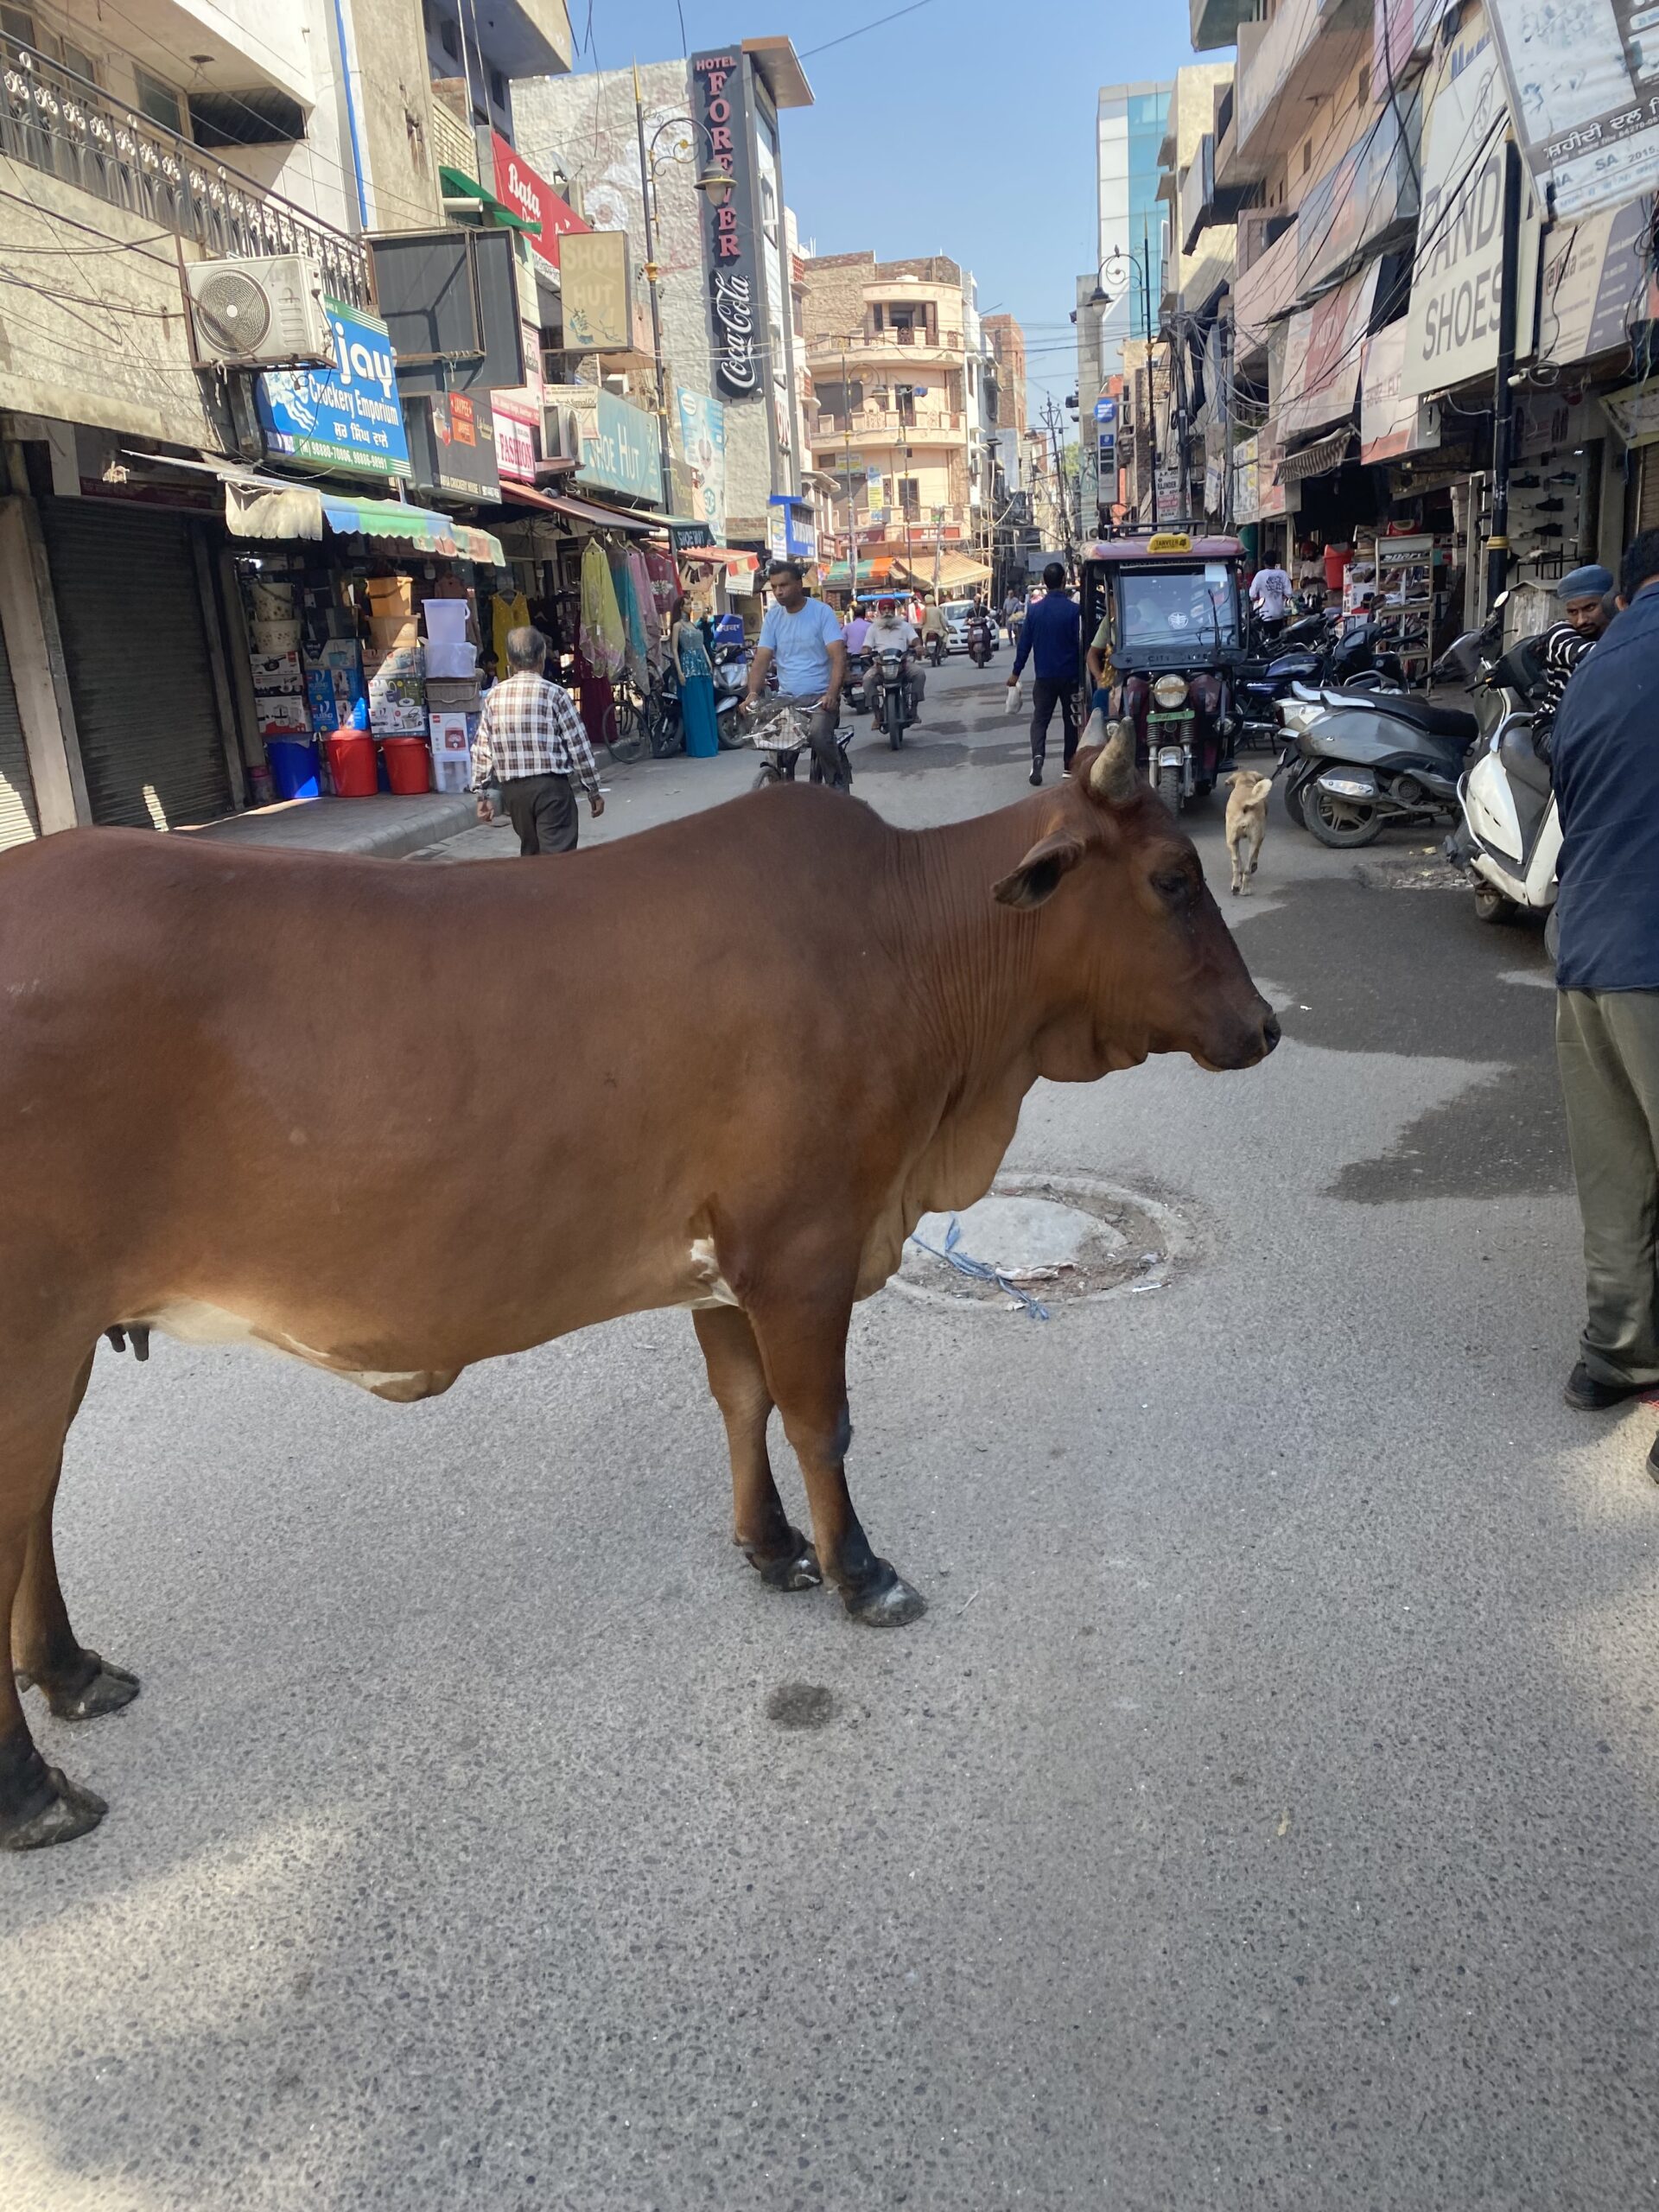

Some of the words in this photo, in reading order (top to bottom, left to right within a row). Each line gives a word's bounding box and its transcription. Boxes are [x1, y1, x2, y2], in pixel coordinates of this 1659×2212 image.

[696, 55, 737, 72] HOTEL
[1594, 153, 1619, 171] SA
[508, 162, 542, 219] Bata
[563, 243, 622, 271] SHOE
[573, 283, 614, 308] HUT
[308, 373, 354, 419] Crockery
[354, 389, 399, 427] Emporium
[454, 397, 470, 417] JAYPEE
[499, 432, 533, 469] FASHION
[617, 422, 640, 482] HUT
[677, 530, 693, 546] SHOE
[694, 530, 704, 545] HUT
[1154, 538, 1179, 548] TANVEER
[1147, 654, 1170, 663] CITY
